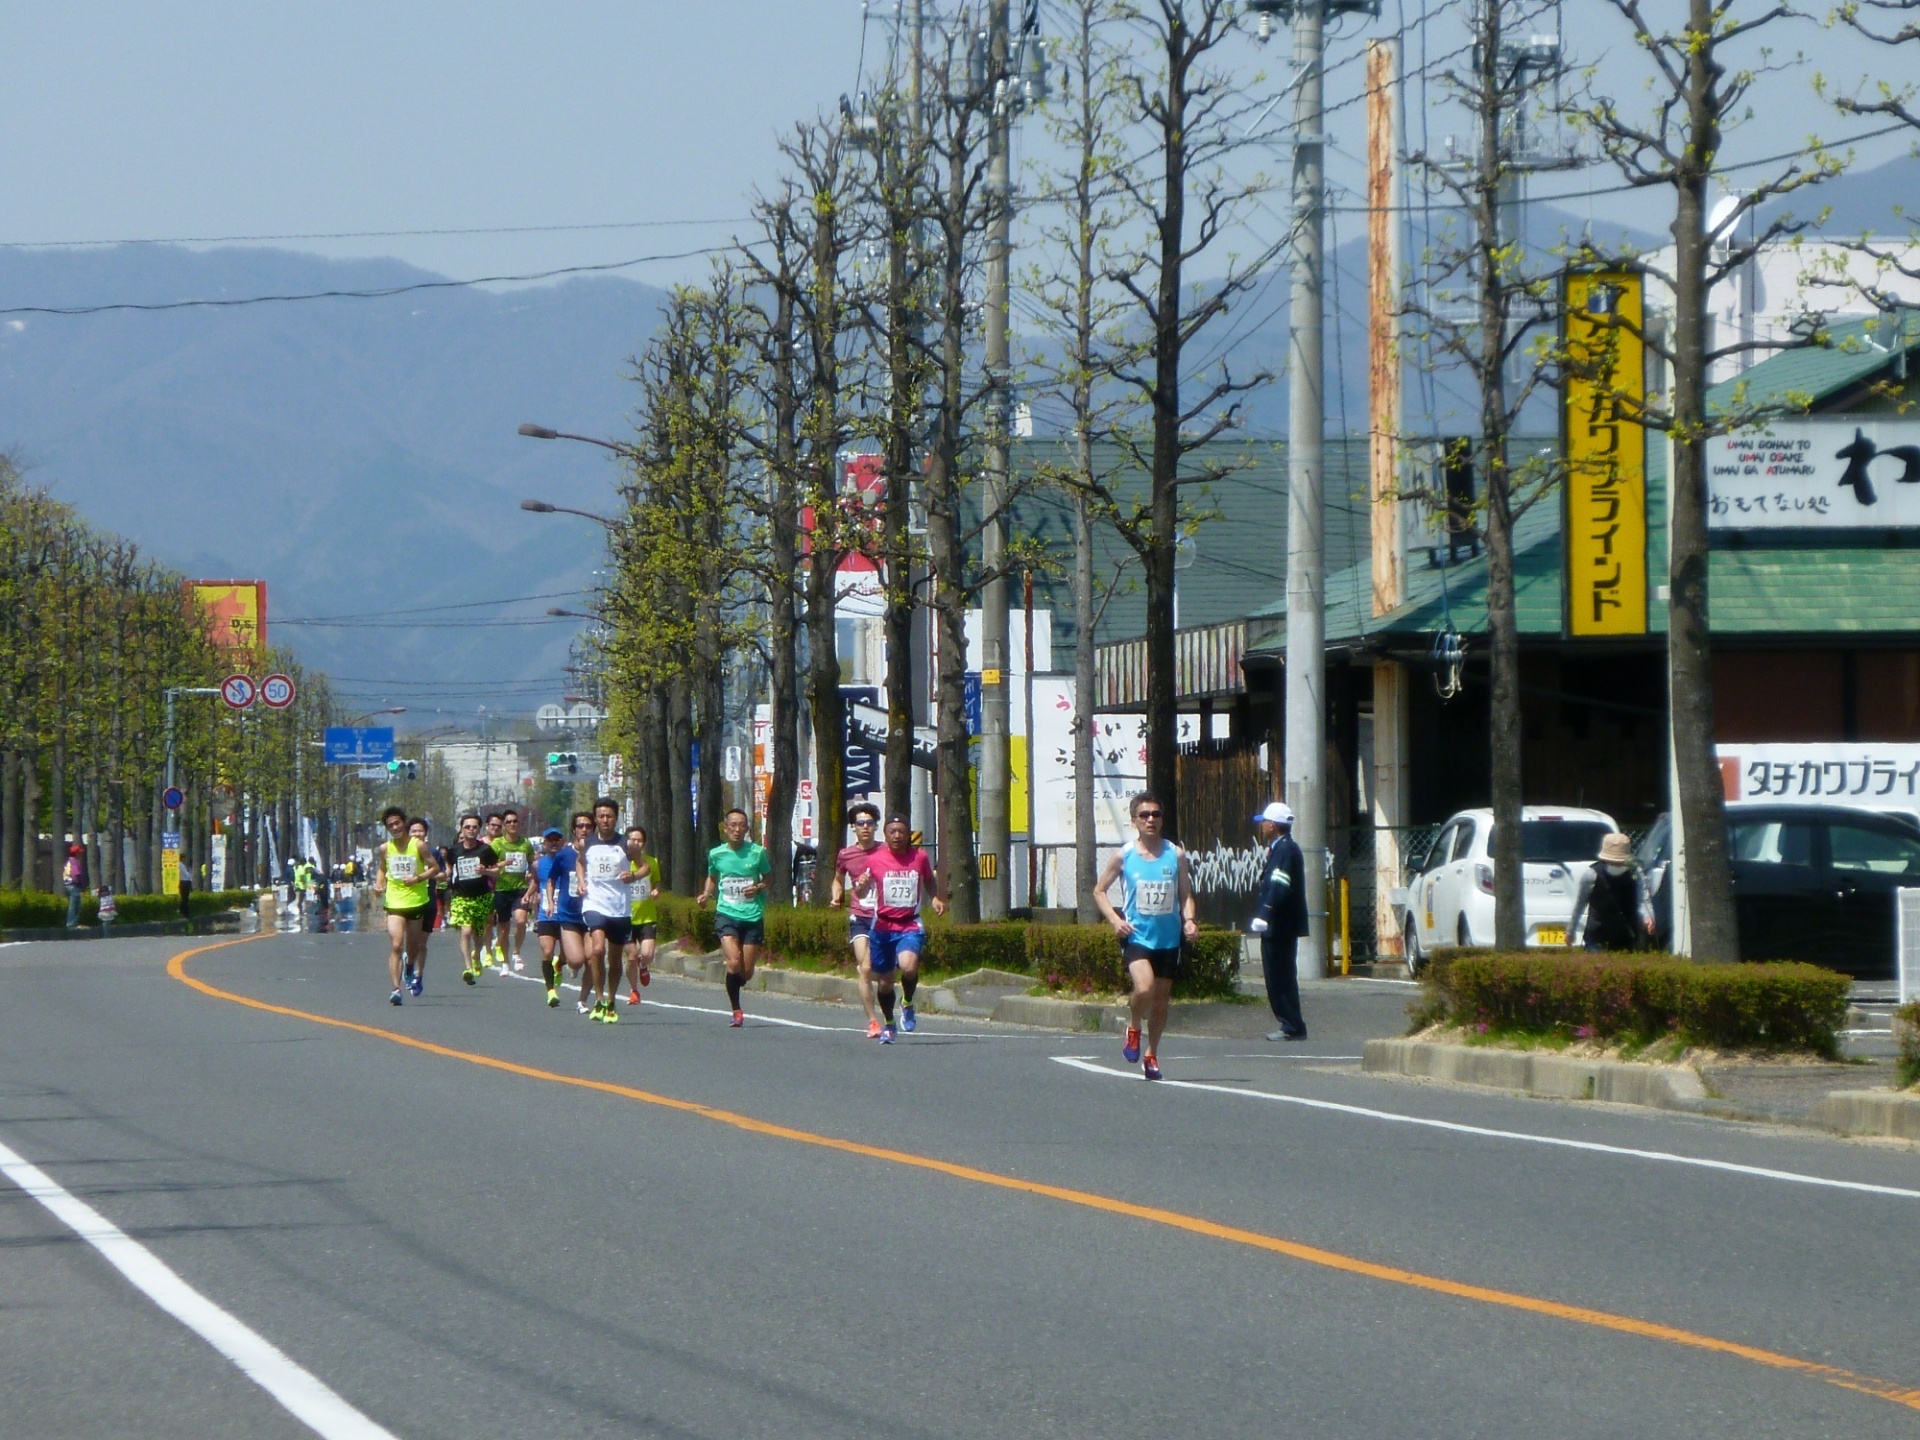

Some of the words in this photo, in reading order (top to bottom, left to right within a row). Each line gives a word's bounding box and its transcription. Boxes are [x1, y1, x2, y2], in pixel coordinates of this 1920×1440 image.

[1727, 440, 1753, 450] UMAI
[1758, 440, 1794, 450] GOHAN
[1798, 440, 1811, 450] TO
[1739, 452, 1765, 463] UMAI
[1770, 452, 1804, 463] OSAKE
[1713, 465, 1740, 476] UMAI
[1744, 465, 1758, 476] GA
[1766, 465, 1815, 476] ATUMARU
[268, 683, 288, 699] 50
[395, 863, 411, 872] 135
[599, 863, 612, 873] 86
[891, 887, 911, 898] 273
[1145, 892, 1167, 905] 127
